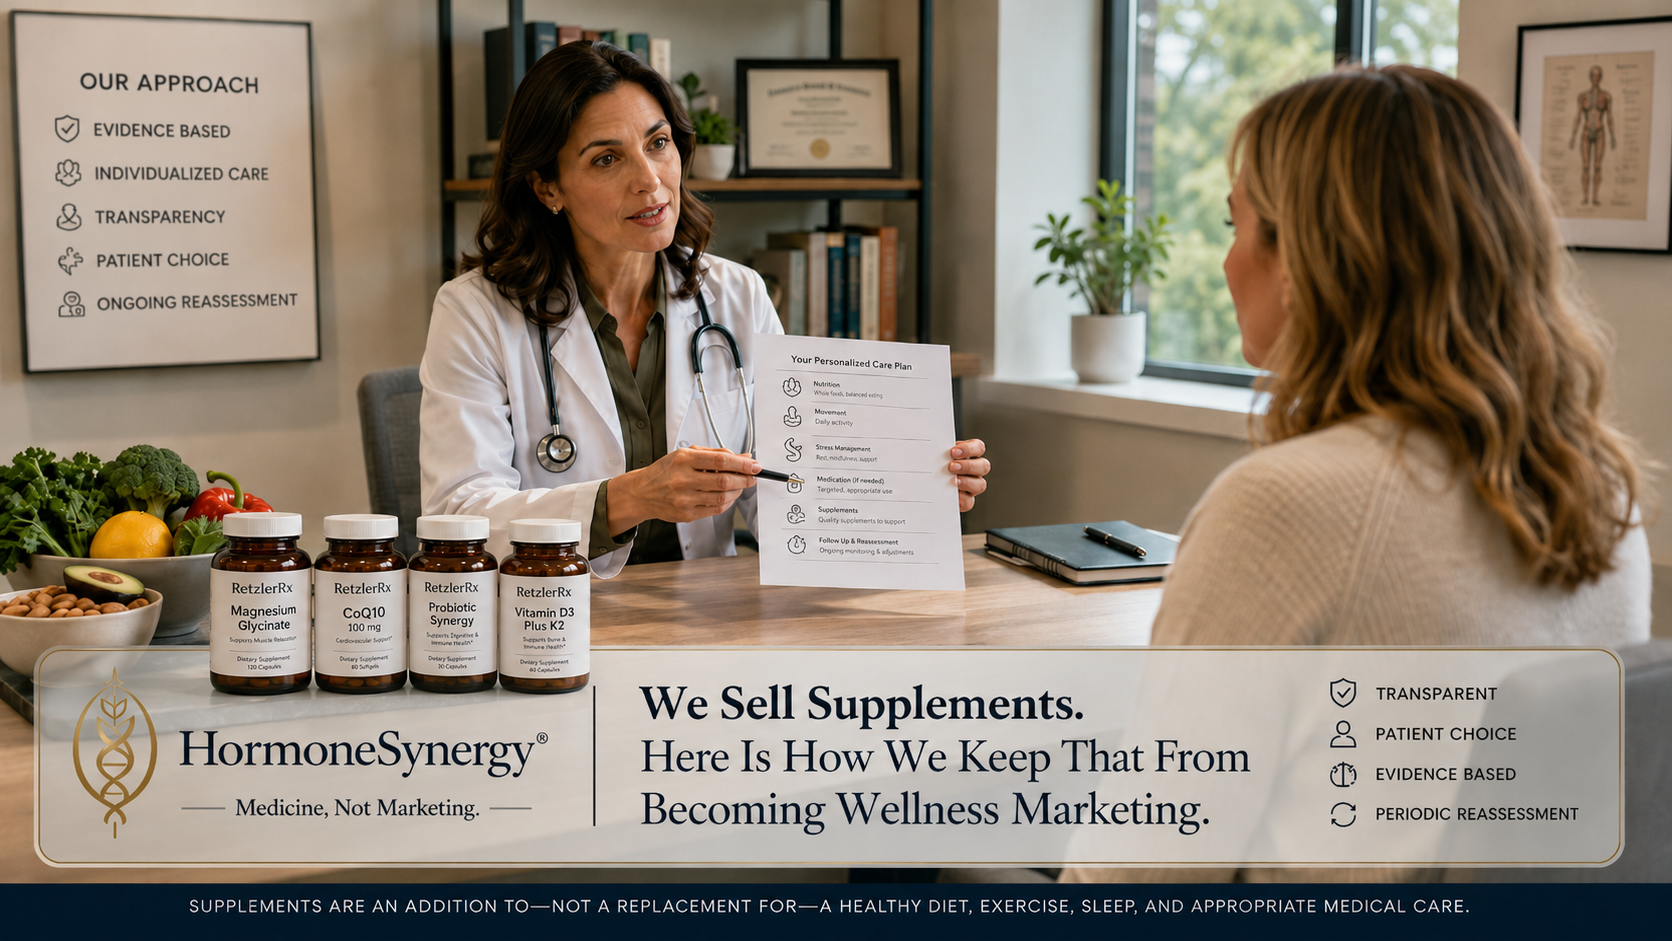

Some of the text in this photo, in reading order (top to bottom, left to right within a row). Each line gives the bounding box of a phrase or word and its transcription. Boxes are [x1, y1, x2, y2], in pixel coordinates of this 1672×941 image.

[80, 72, 259, 94] OUR APPROACH
[94, 123, 231, 138] EVIDENCE BASED
[95, 166, 269, 181] INDIVIDUALIZED CARE
[95, 210, 226, 224] TRANSPARENCY
[97, 253, 229, 268] PATIENT CHOICE
[97, 293, 298, 311] ONGOING REASSESSMENT
[791, 355, 912, 371] Your Personalized Care Plan
[813, 380, 841, 388] Nutrition
[814, 408, 847, 416] Movement
[815, 418, 854, 427] Daily activity
[834, 445, 871, 453] Management
[817, 476, 852, 484] Medication
[860, 477, 885, 485] needed)
[818, 506, 859, 515] Supplements
[818, 517, 839, 525] Quality
[819, 537, 839, 545] Follow
[840, 538, 850, 546] Up
[856, 538, 899, 546] Reassessment
[819, 547, 844, 556] Ongoing
[845, 548, 875, 556] monitoring
[882, 549, 914, 557] adjustments
[232, 582, 293, 595] RetzlerRx
[334, 582, 391, 595] RetzlerRx
[424, 581, 479, 593] RetzlerRx
[516, 586, 572, 598] RetzlerRx
[231, 605, 297, 620] Magnesium
[343, 606, 386, 620] CoQ10
[429, 602, 477, 613] Probiotic
[515, 607, 575, 618] Vitamin D3
[238, 620, 291, 633] Glycinate
[430, 615, 474, 628] Synergy
[524, 620, 565, 631] Plus K2
[348, 623, 381, 633] 100 mg
